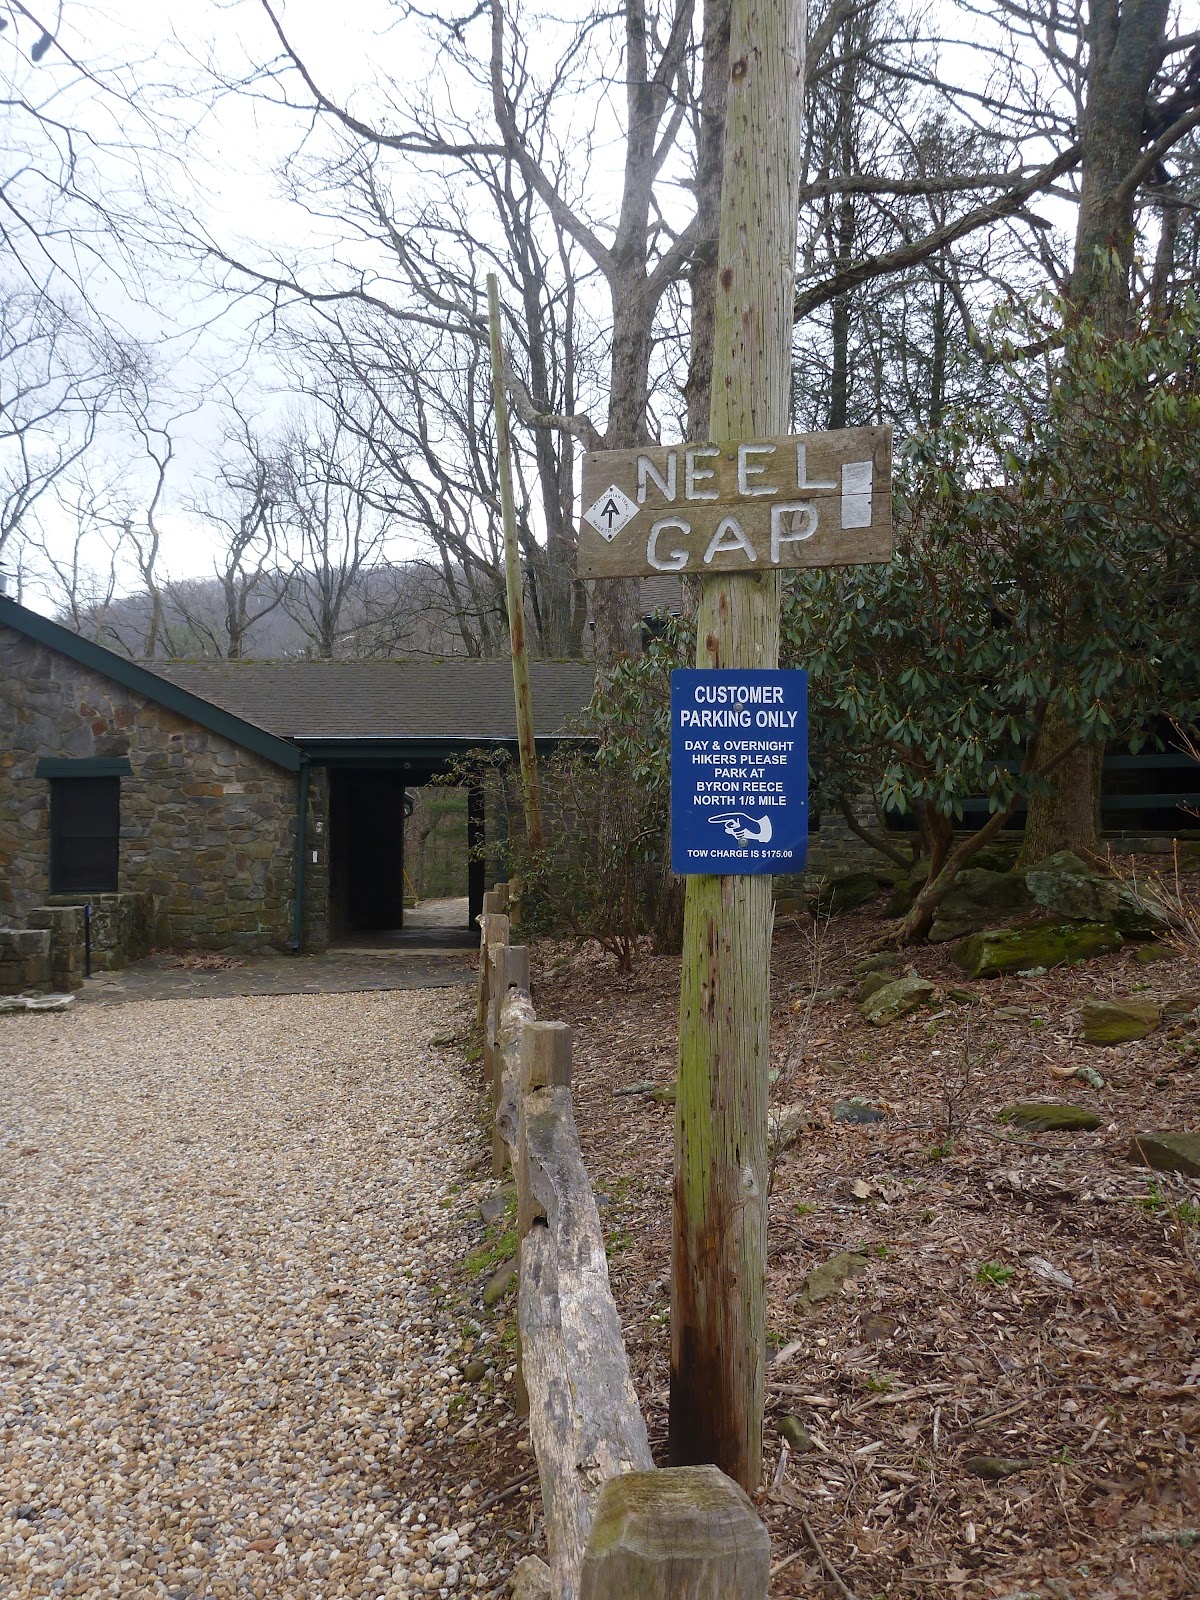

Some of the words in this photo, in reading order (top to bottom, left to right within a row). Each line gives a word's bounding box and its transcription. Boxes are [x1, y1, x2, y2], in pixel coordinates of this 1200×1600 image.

[637, 441, 839, 503] NEEL
[646, 502, 819, 570] GAP
[694, 685, 784, 704] CUSTOMER
[680, 709, 752, 728] PARKING
[755, 710, 798, 728] ONLY
[684, 741, 709, 751] DAY
[711, 741, 721, 751] &
[723, 741, 795, 751] OVERNIGHT
[692, 754, 737, 765] HIKERS
[740, 755, 788, 765] PLEASE
[714, 768, 747, 778] PARK
[749, 768, 766, 778] AT
[696, 782, 740, 792] BYRON
[742, 782, 784, 792] REECE
[693, 795, 736, 805] NORTH
[738, 795, 756, 805] 1/8
[758, 795, 787, 806] MILE
[687, 849, 709, 858] TOW
[710, 849, 749, 858] CHARGE
[750, 849, 760, 858] IS
[761, 849, 793, 858] $175.00
